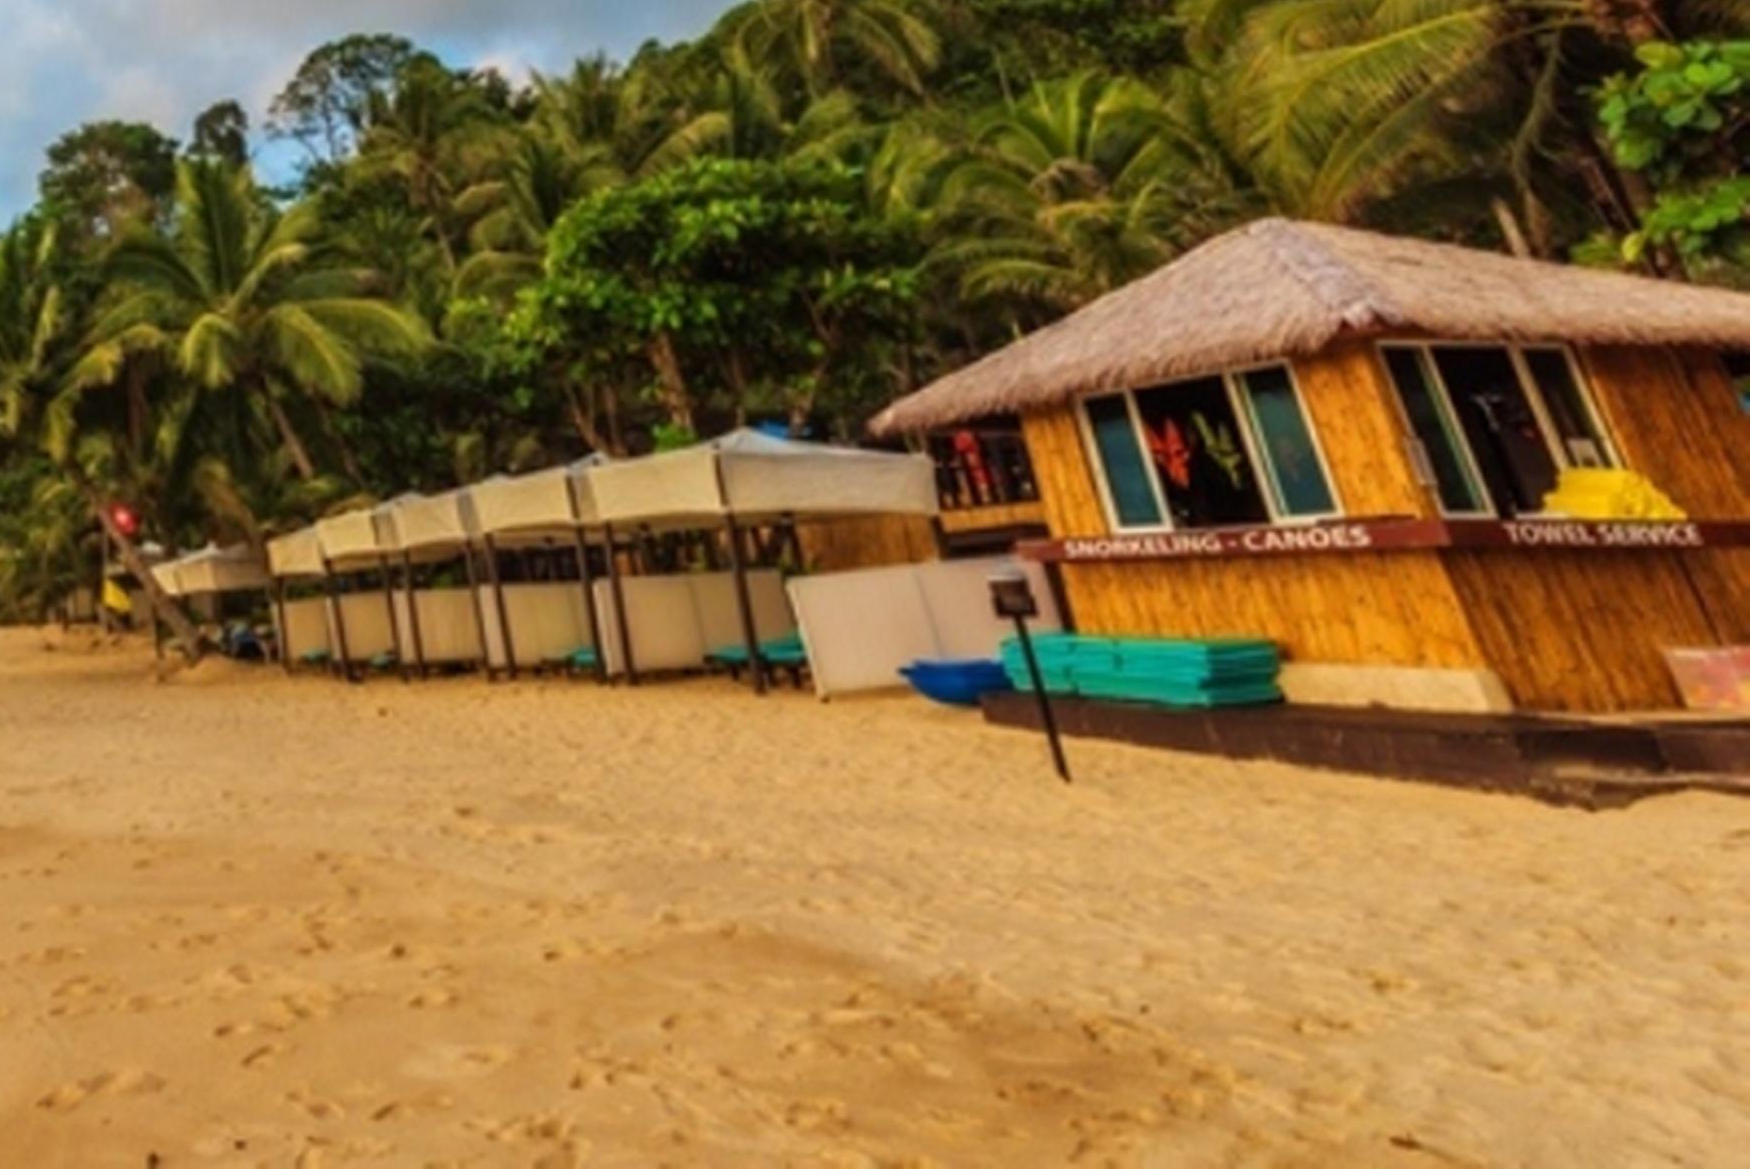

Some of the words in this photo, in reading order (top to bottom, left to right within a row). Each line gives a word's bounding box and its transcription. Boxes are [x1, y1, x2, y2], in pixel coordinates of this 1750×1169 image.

[1064, 533, 1221, 559] SNORKELING
[1243, 524, 1371, 552] CANOES
[1503, 522, 1596, 545] TOWEL
[1600, 522, 1704, 546] SERVICE
